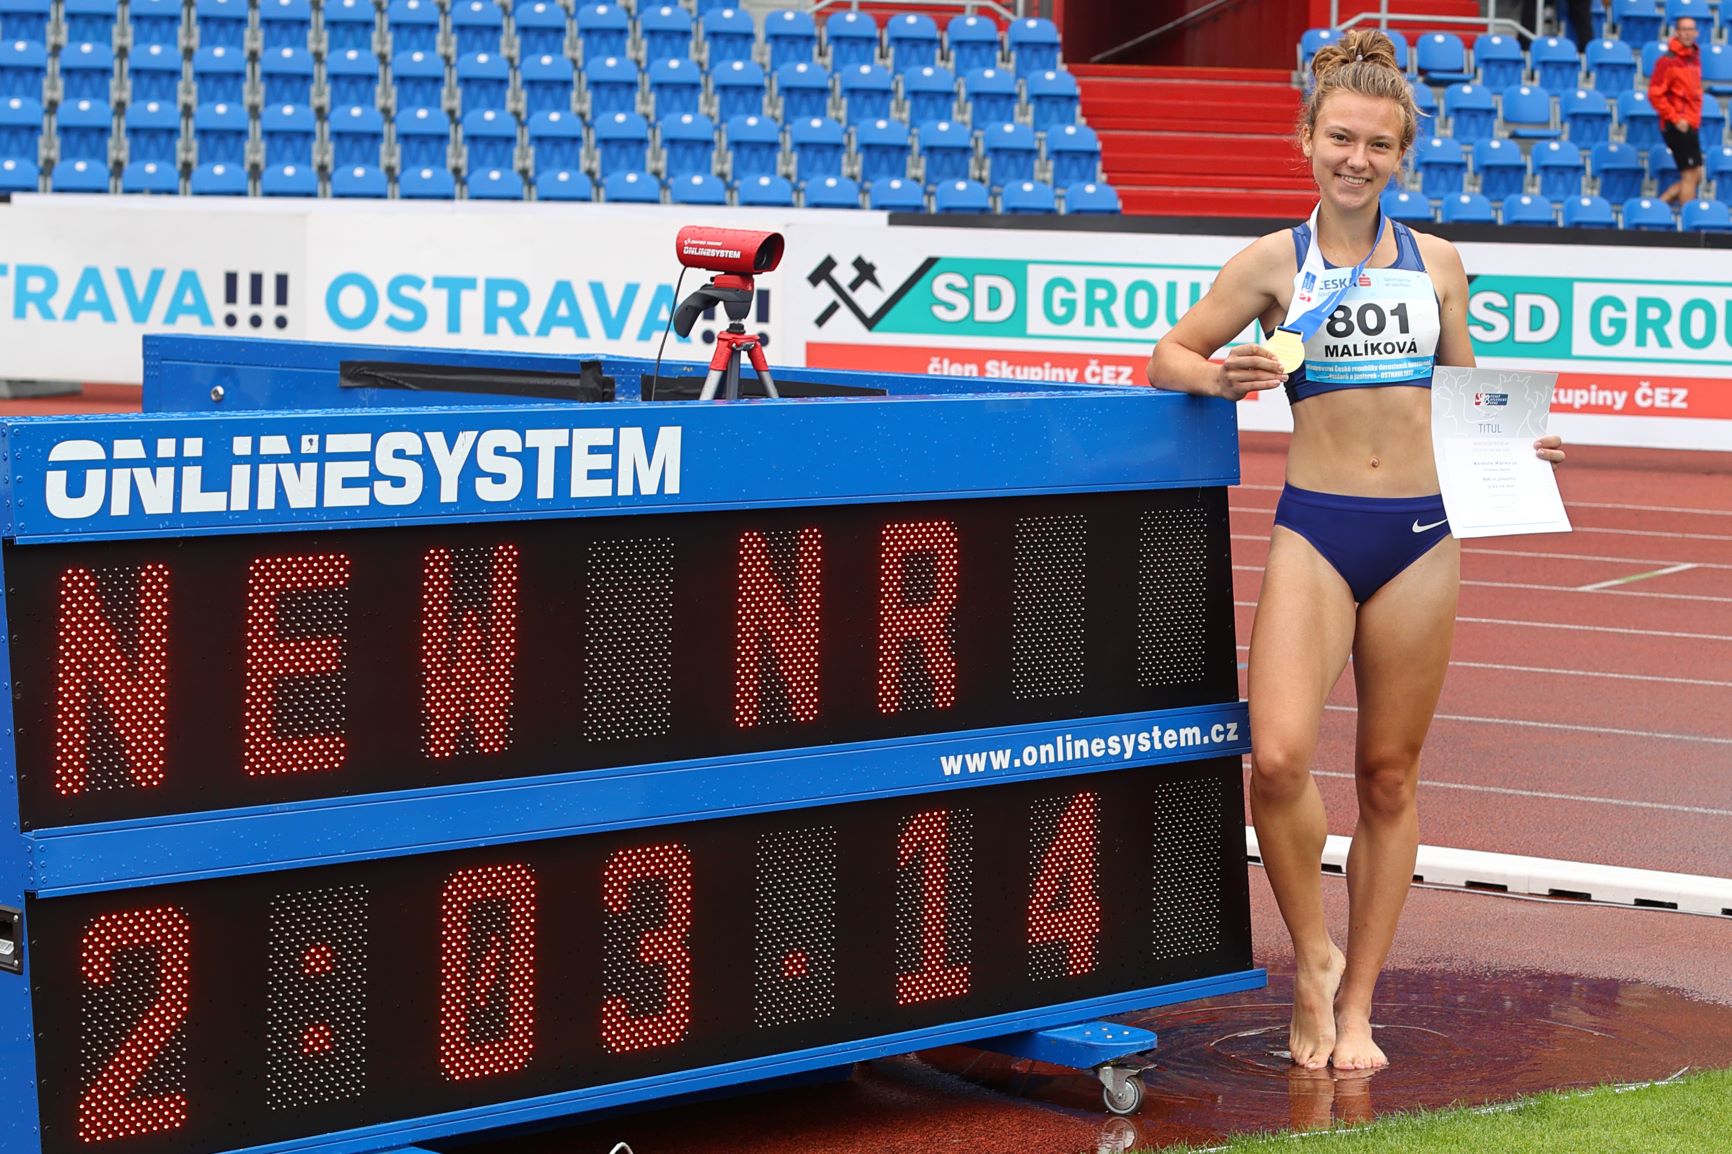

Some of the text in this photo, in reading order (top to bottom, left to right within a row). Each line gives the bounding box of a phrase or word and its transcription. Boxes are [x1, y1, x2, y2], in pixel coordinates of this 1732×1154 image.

[0, 263, 289, 330] RAVA!!!
[930, 272, 1214, 329] SD GROU
[1326, 302, 1410, 338] 801
[1468, 290, 1560, 344] SD
[927, 357, 1133, 385] člen Skupiny ČEZ
[1324, 338, 1418, 357] MALÍKOVÁ
[1634, 381, 1688, 409] ČEZ
[1478, 424, 1503, 434] TITUL
[45, 425, 682, 519] ONLINESYSTEM
[55, 520, 959, 796] NEW NR
[940, 720, 1239, 776] www.onlinesystem.cz
